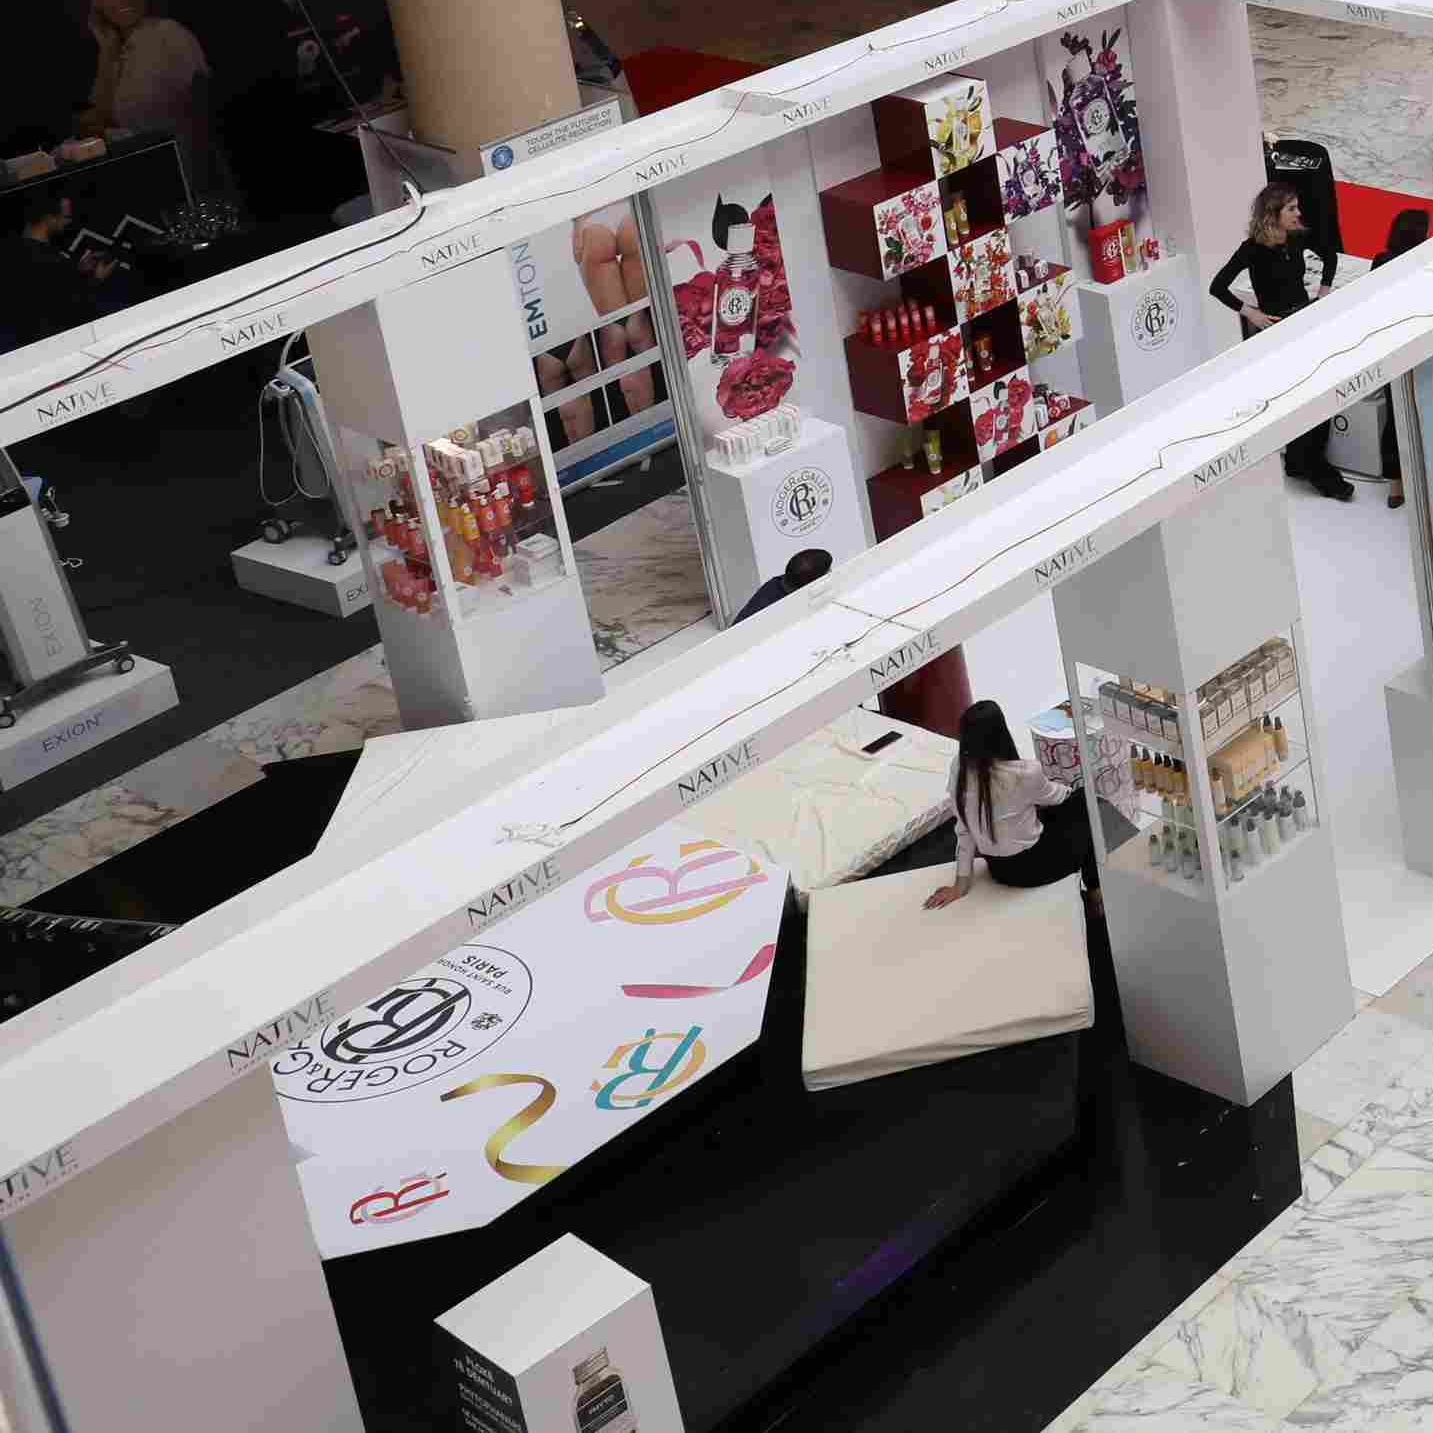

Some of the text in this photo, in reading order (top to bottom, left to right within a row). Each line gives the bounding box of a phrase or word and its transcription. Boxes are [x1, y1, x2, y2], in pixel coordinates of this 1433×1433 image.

[1345, 3, 1388, 24] NATIVE
[923, 44, 969, 72] NATIVE
[783, 95, 832, 126] NATIVE
[635, 152, 689, 183] NATIVE
[421, 232, 482, 269] NATIVE
[512, 242, 548, 341] EMTON
[220, 311, 289, 353] NATIVE
[36, 380, 115, 423] NATIVE
[1334, 363, 1385, 401] NATIVE
[1192, 443, 1250, 488] NATIVE
[1033, 533, 1097, 585] NATIVE
[868, 629, 938, 684] NATIVE
[41, 710, 102, 754] EXION
[675, 737, 759, 802] NATIVE
[467, 856, 562, 927] NATIVE
[462, 954, 508, 979] PARIS
[224, 988, 336, 1069] NATIVE
[0, 1140, 76, 1203] TIVE
